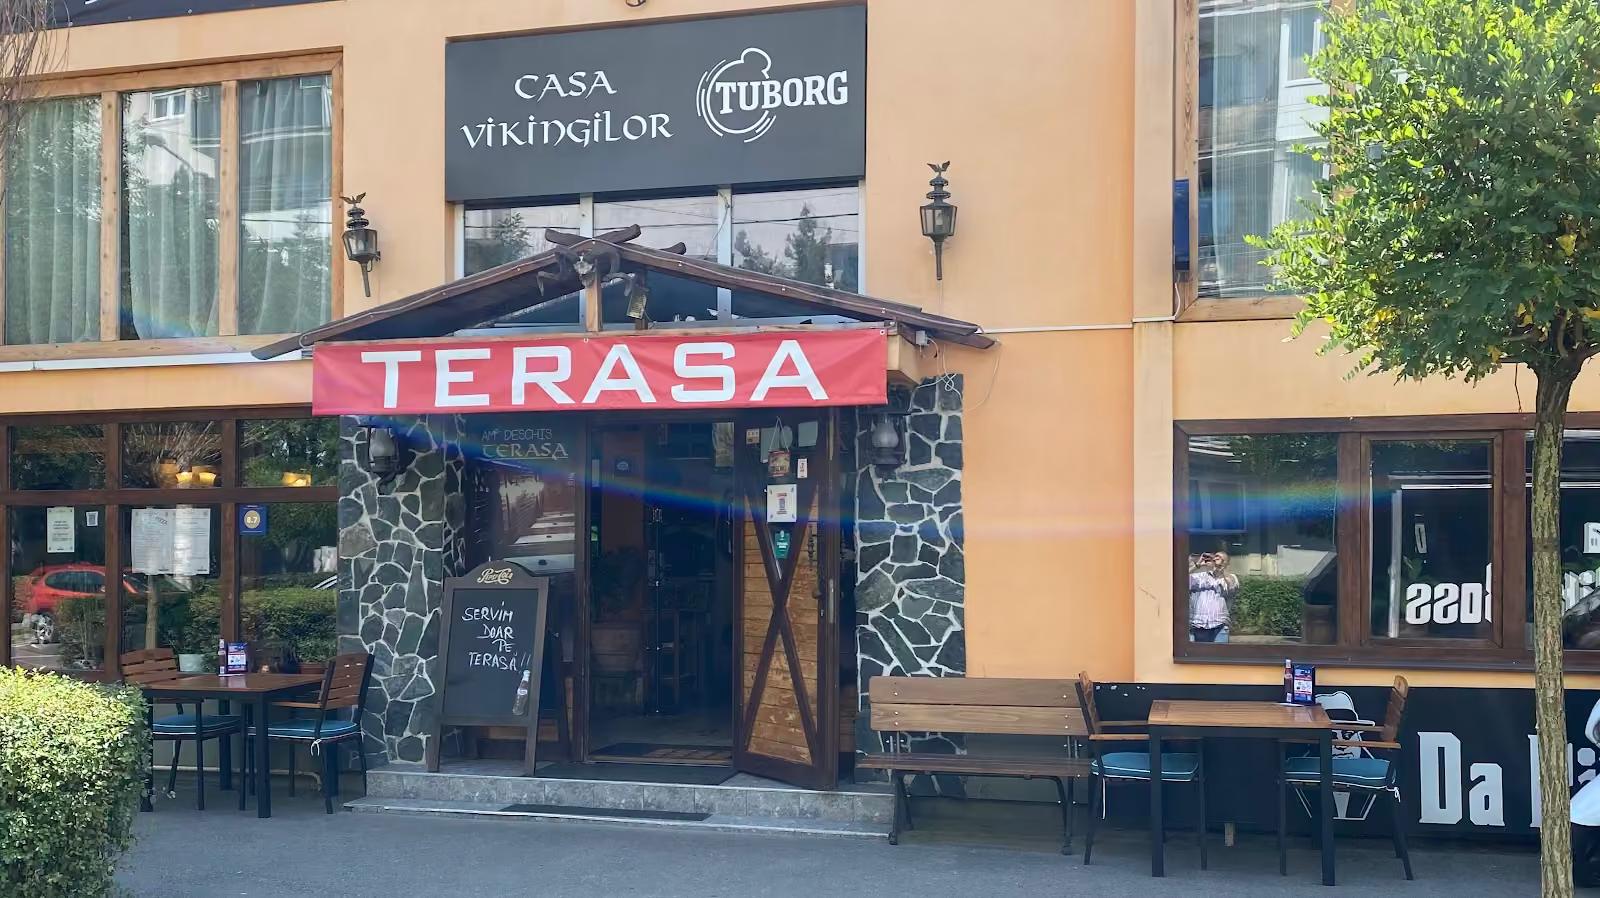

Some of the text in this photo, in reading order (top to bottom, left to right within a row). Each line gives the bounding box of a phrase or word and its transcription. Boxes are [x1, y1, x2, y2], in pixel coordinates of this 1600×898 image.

[514, 70, 617, 102] CASA
[715, 70, 849, 115] TUBORG
[361, 339, 829, 409] TERASA
[504, 428, 553, 441] DESCHIS
[476, 624, 515, 640] DOAR
[491, 639, 515, 653] PE
[1417, 731, 1506, 827] Da
